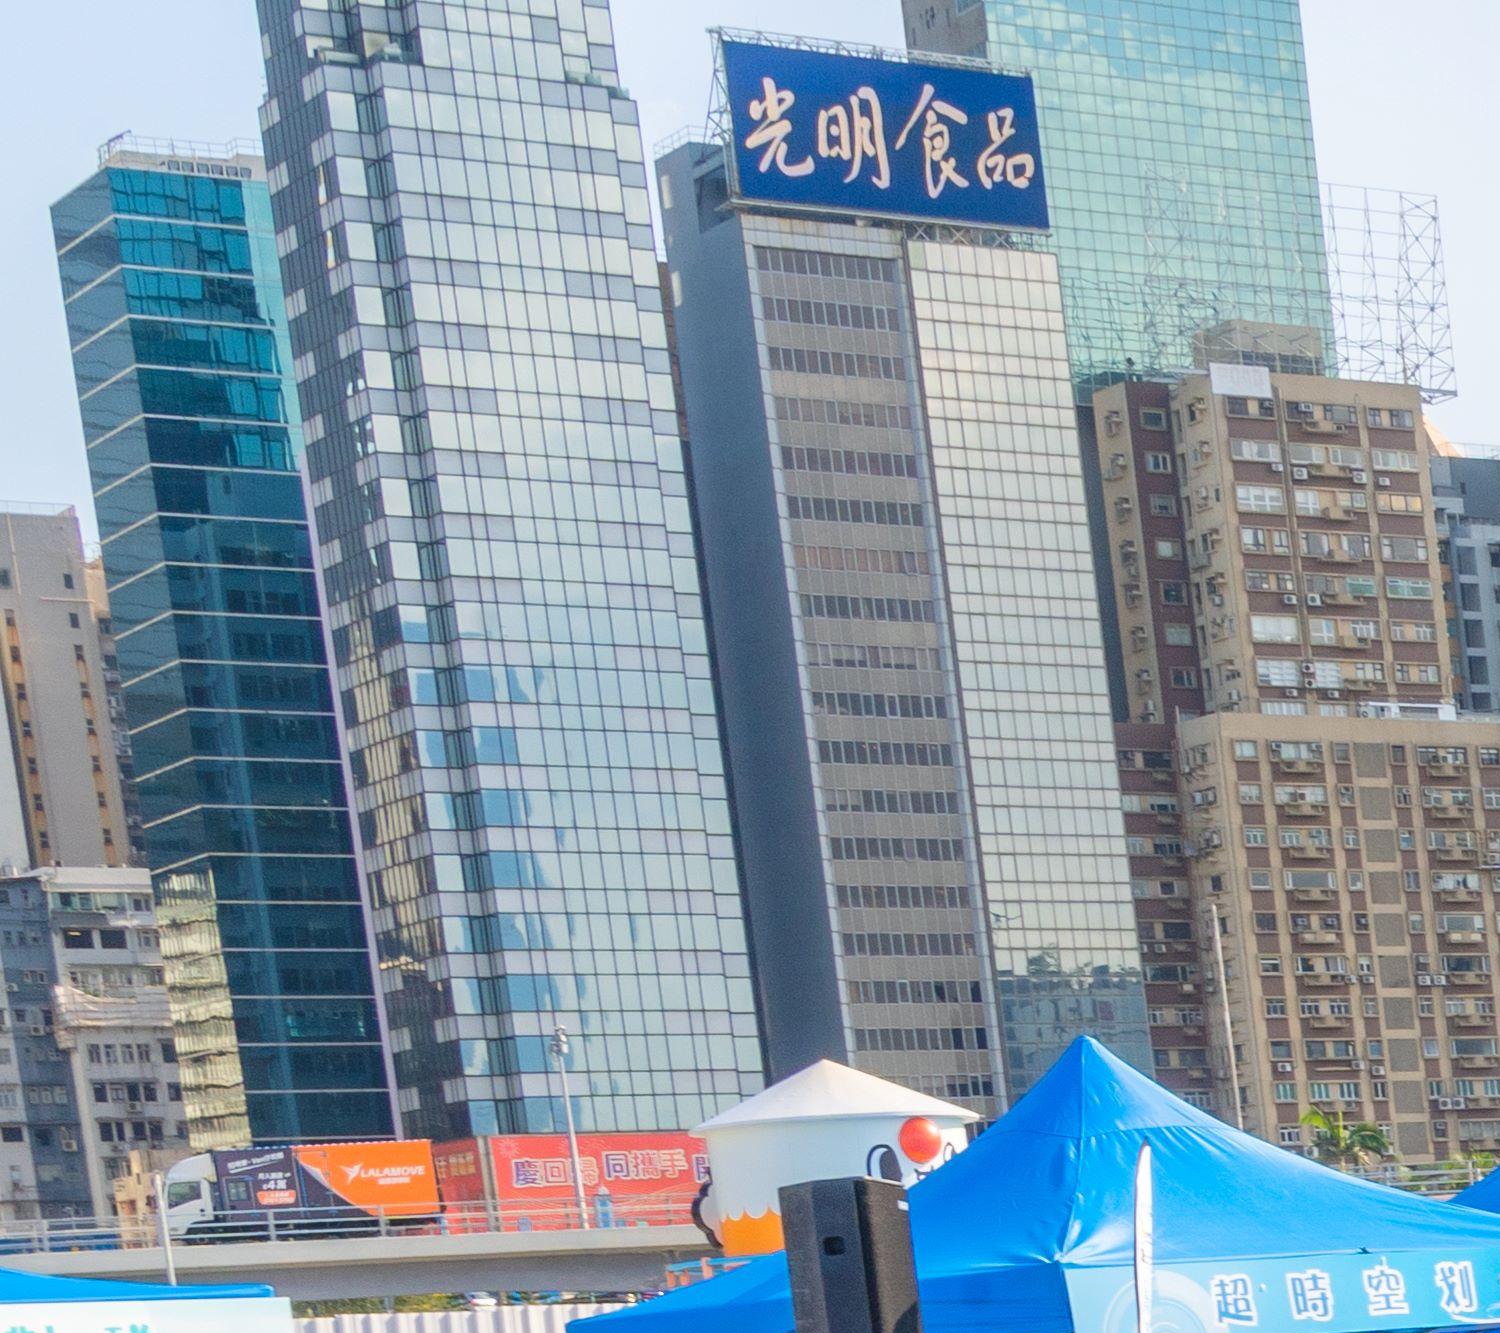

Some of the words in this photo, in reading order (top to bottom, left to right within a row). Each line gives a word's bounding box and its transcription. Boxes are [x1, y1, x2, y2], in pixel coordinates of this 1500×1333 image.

[744, 77, 1035, 199] 光明食品
[361, 1165, 425, 1178] LALAMOVE
